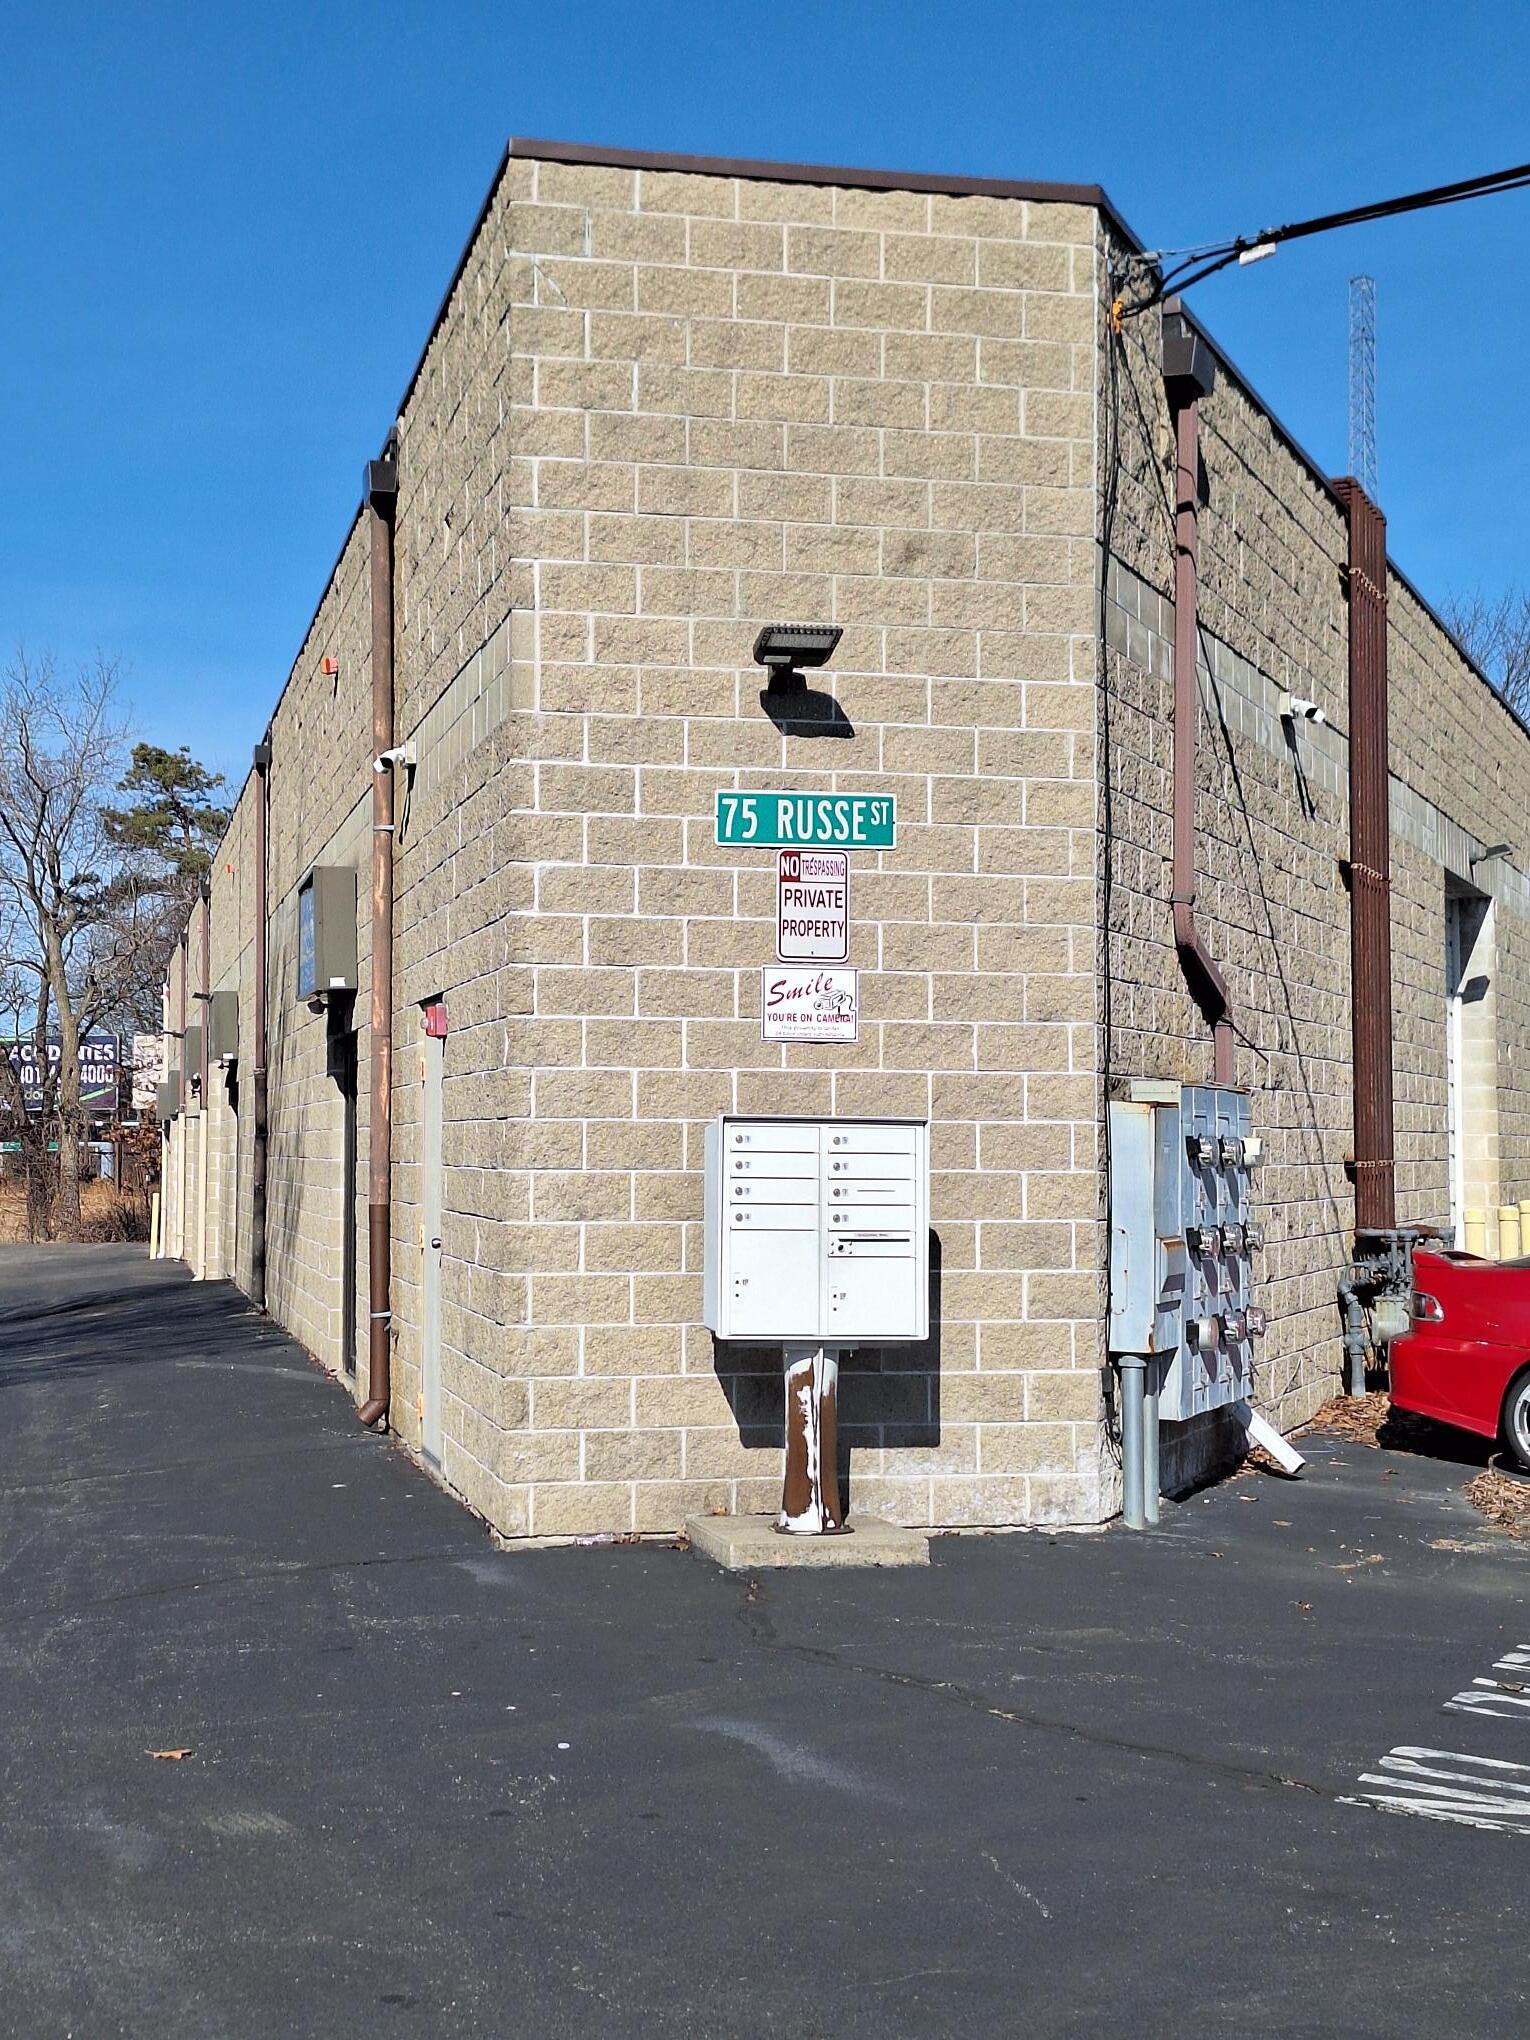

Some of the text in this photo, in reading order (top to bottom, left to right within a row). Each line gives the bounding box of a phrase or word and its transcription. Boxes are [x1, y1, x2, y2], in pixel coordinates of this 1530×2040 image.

[722, 798, 890, 841] 75 RUSSE ST
[780, 856, 845, 877] NO TRESPASSING
[784, 888, 844, 909] PRIVATE
[782, 919, 845, 938] PROPERTY
[767, 972, 833, 1006] Smile
[767, 1013, 798, 1022] YOU'RE
[800, 1013, 812, 1022] ON
